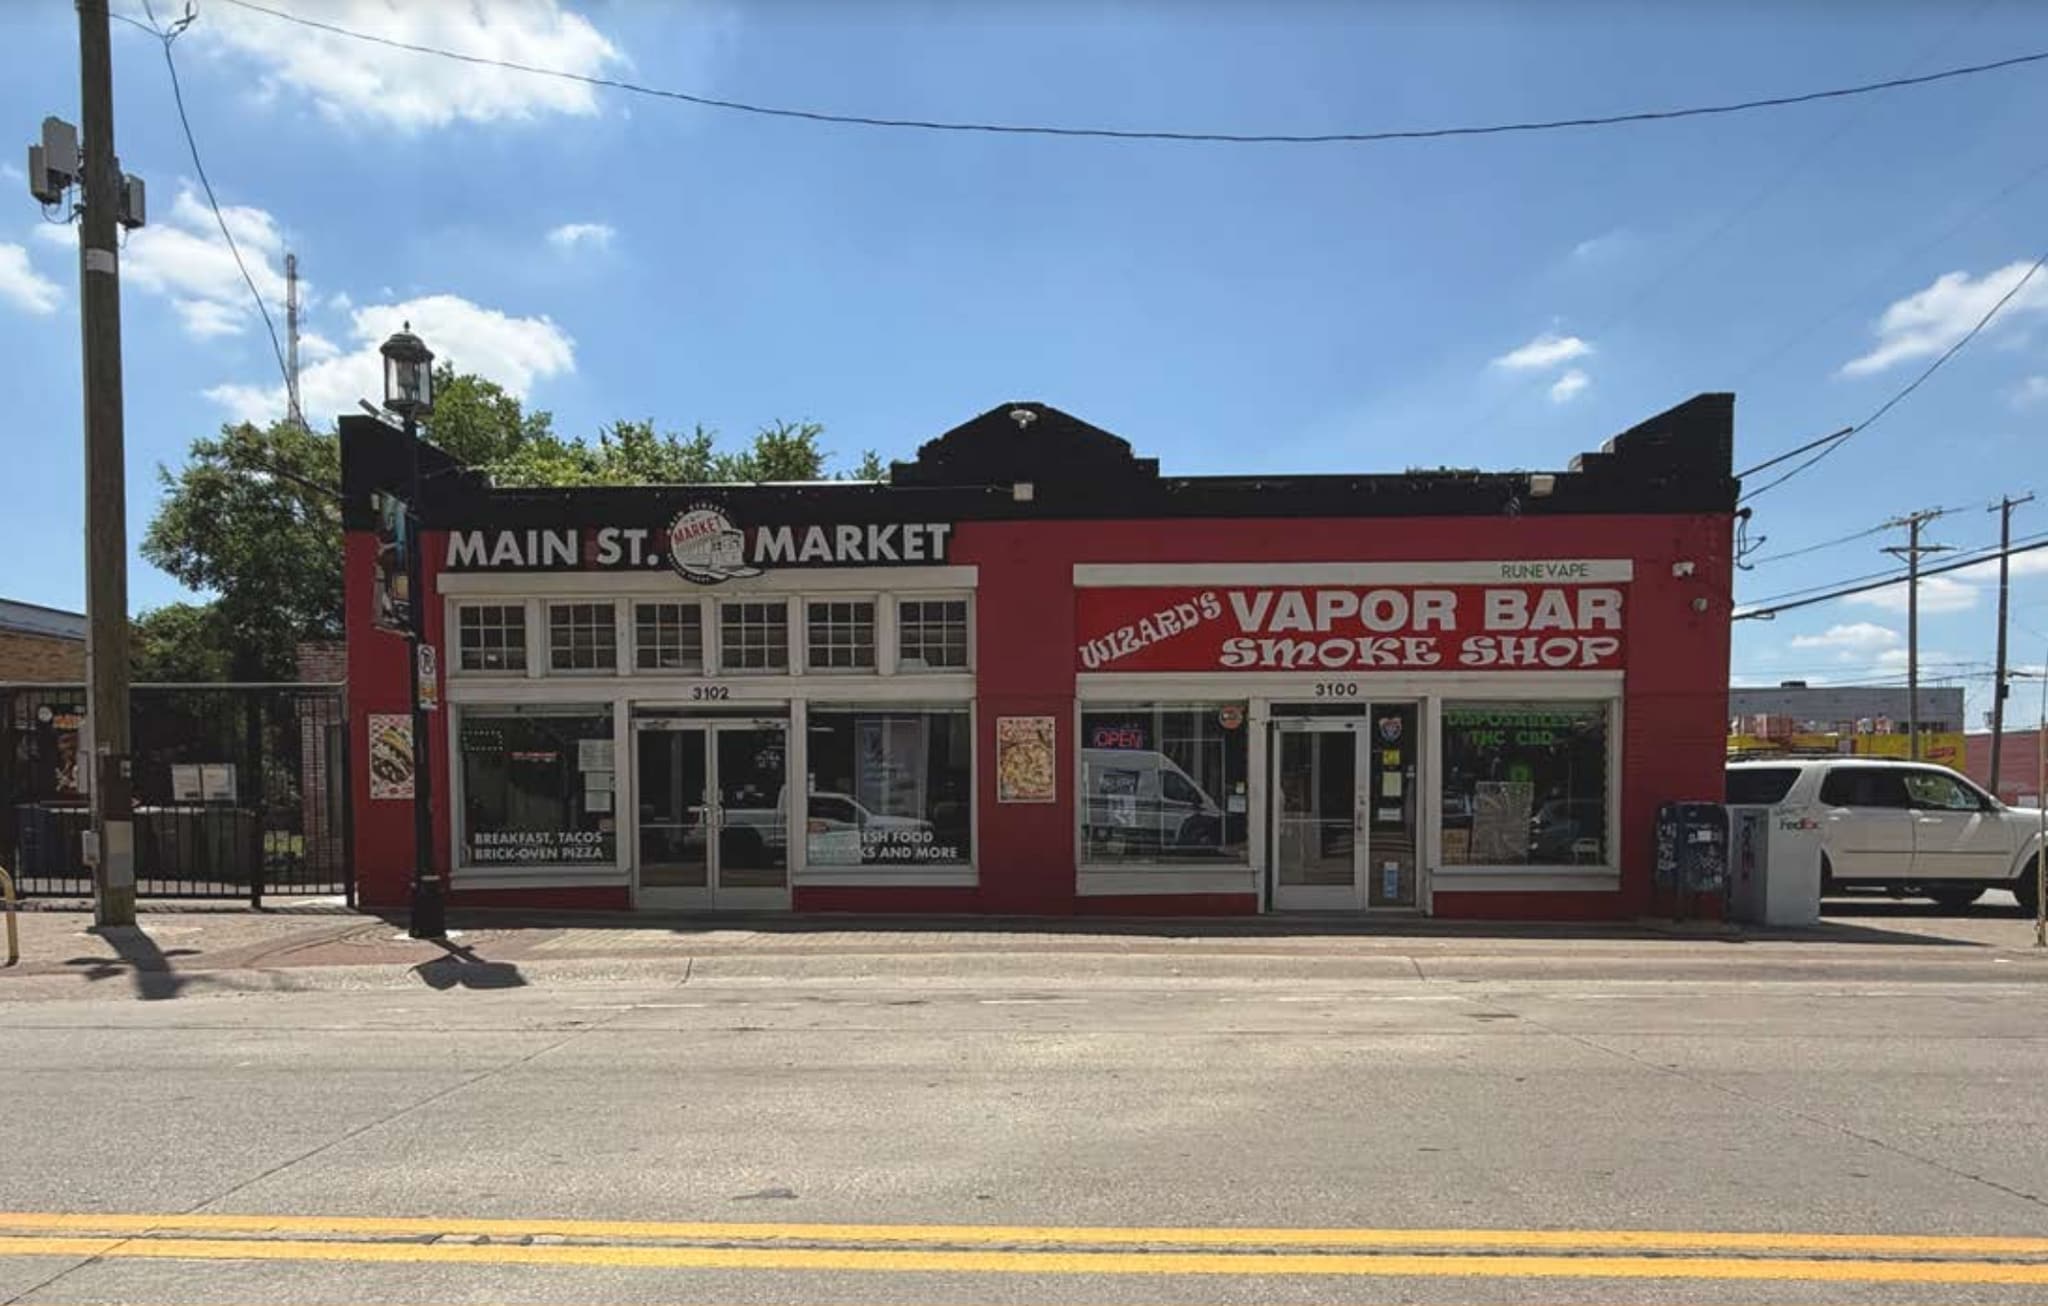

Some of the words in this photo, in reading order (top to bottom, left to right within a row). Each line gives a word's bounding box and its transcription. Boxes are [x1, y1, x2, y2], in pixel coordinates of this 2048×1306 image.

[673, 515, 720, 544] MARKET
[446, 529, 578, 567] MAIN
[597, 527, 659, 566] ST.
[754, 523, 951, 562] MARKET
[1228, 589, 1457, 633] VAPOR
[1484, 589, 1623, 631] BAR
[1079, 591, 1223, 670] WIZARD'S
[1219, 636, 1441, 669] SMOKE
[1459, 635, 1620, 667] SHOP
[692, 686, 730, 701] 3102
[1315, 682, 1358, 697] 3100
[1097, 730, 1143, 748] OPEN
[475, 832, 554, 845] BREAKFAST,
[559, 832, 603, 844] TACOS
[893, 831, 934, 844] FOOD
[475, 847, 558, 860] BRICK-OVEN
[562, 847, 603, 859] PIZZA
[880, 847, 912, 859] AND
[915, 847, 958, 859] MORE
